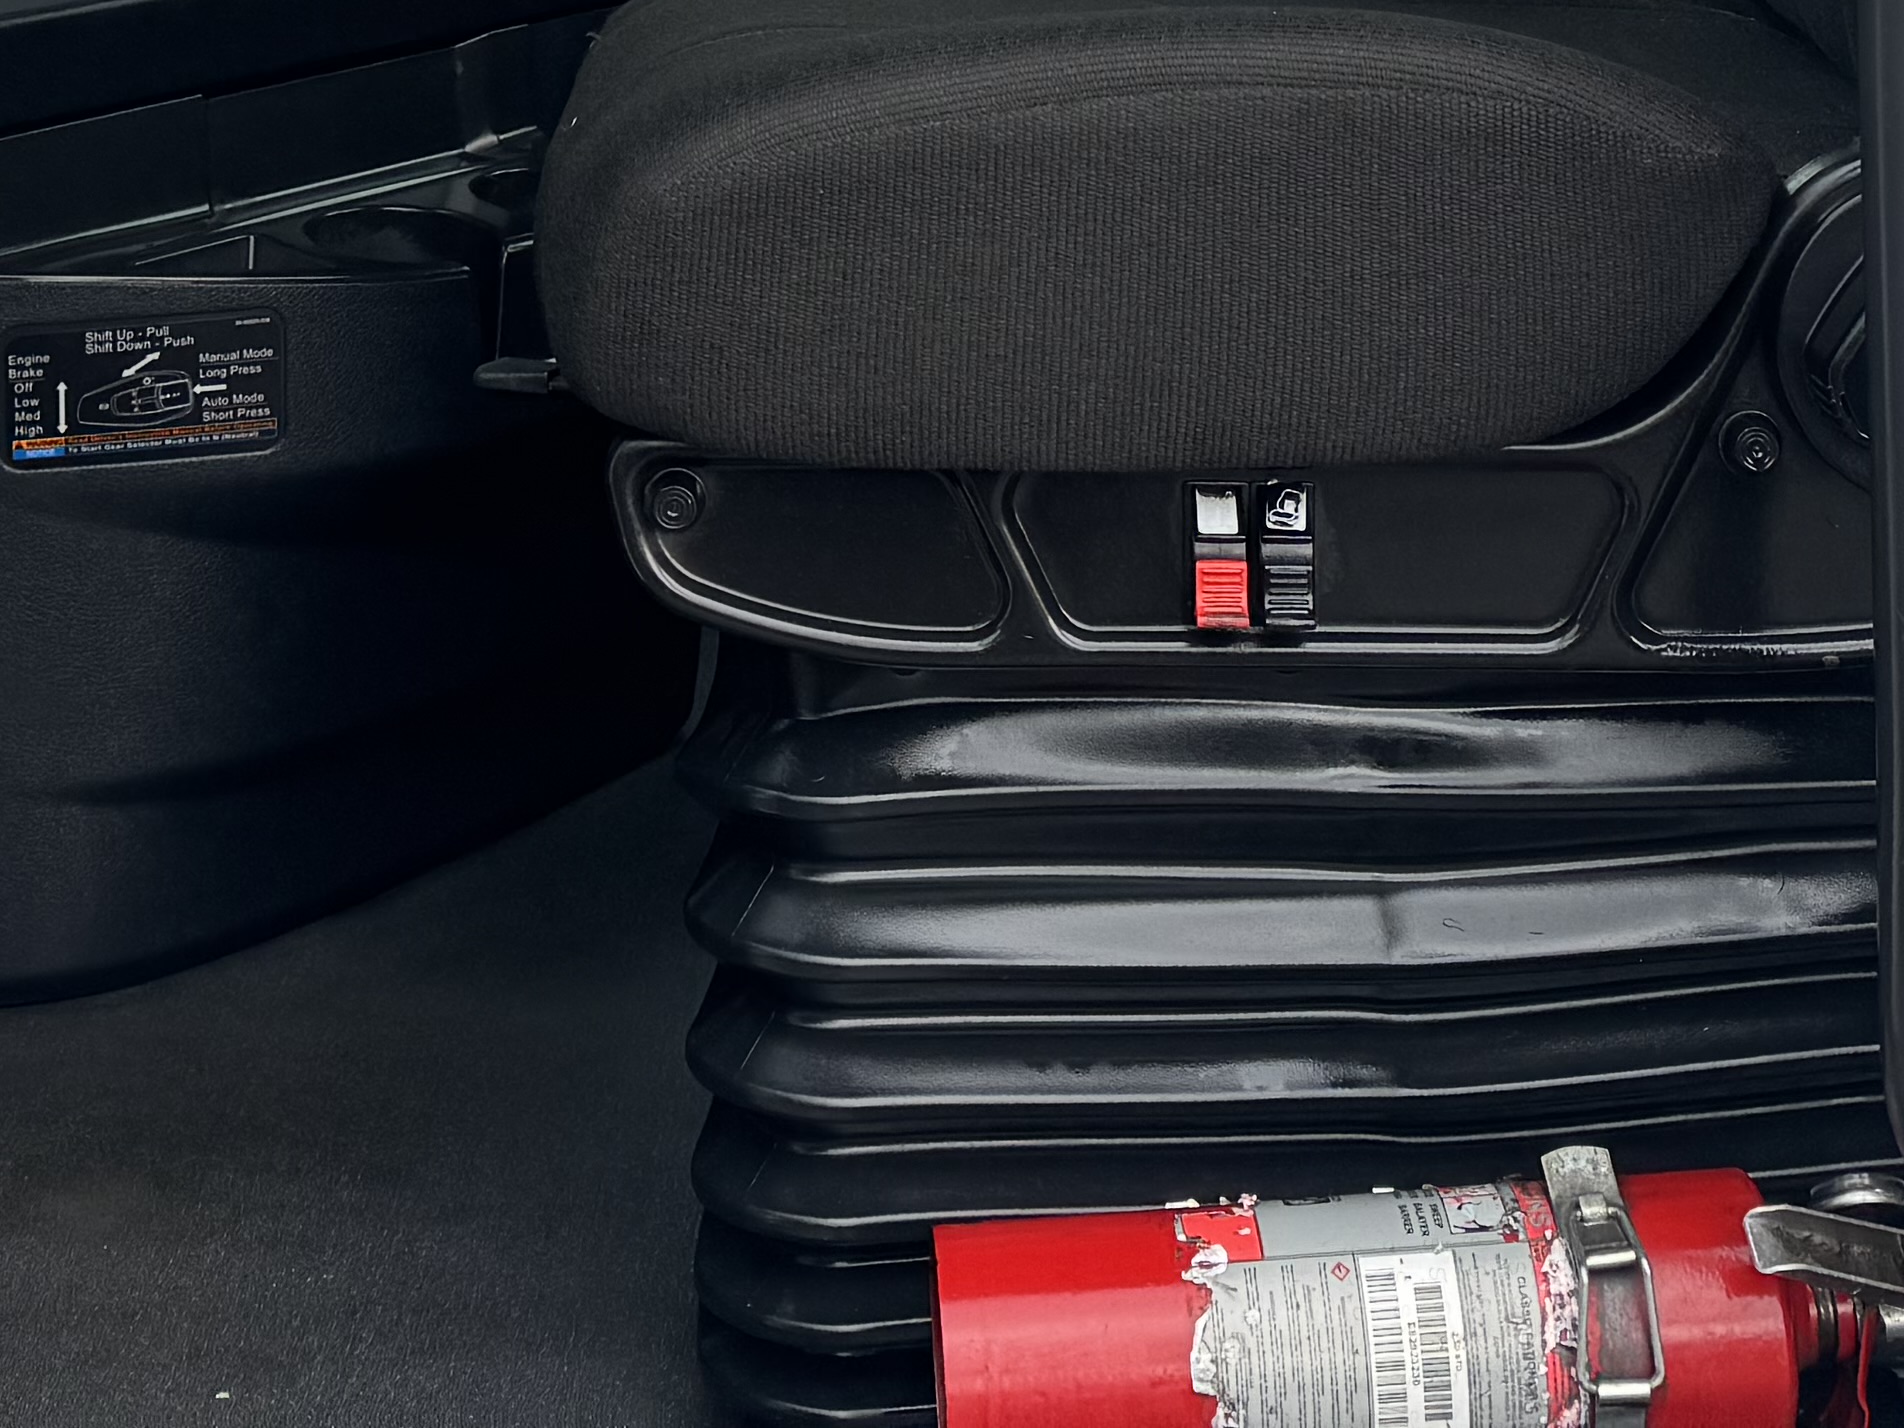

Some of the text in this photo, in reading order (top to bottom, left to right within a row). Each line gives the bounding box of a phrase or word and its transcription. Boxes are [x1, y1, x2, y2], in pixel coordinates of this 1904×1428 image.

[85, 330, 113, 343] Shift
[116, 329, 134, 341] Up
[146, 326, 169, 337] Pull
[85, 342, 113, 354] Shift
[116, 340, 151, 352] Down
[164, 335, 195, 347] Push
[8, 353, 50, 367] Engine
[199, 347, 274, 363] Manual Mode
[8, 367, 44, 379] Brake
[199, 365, 262, 379] Long Press
[14, 382, 34, 394] Off
[14, 397, 40, 408] Low
[201, 393, 265, 407] Auto Mode
[14, 410, 41, 422] Med
[202, 407, 271, 422] Short Press
[14, 425, 44, 438] High
